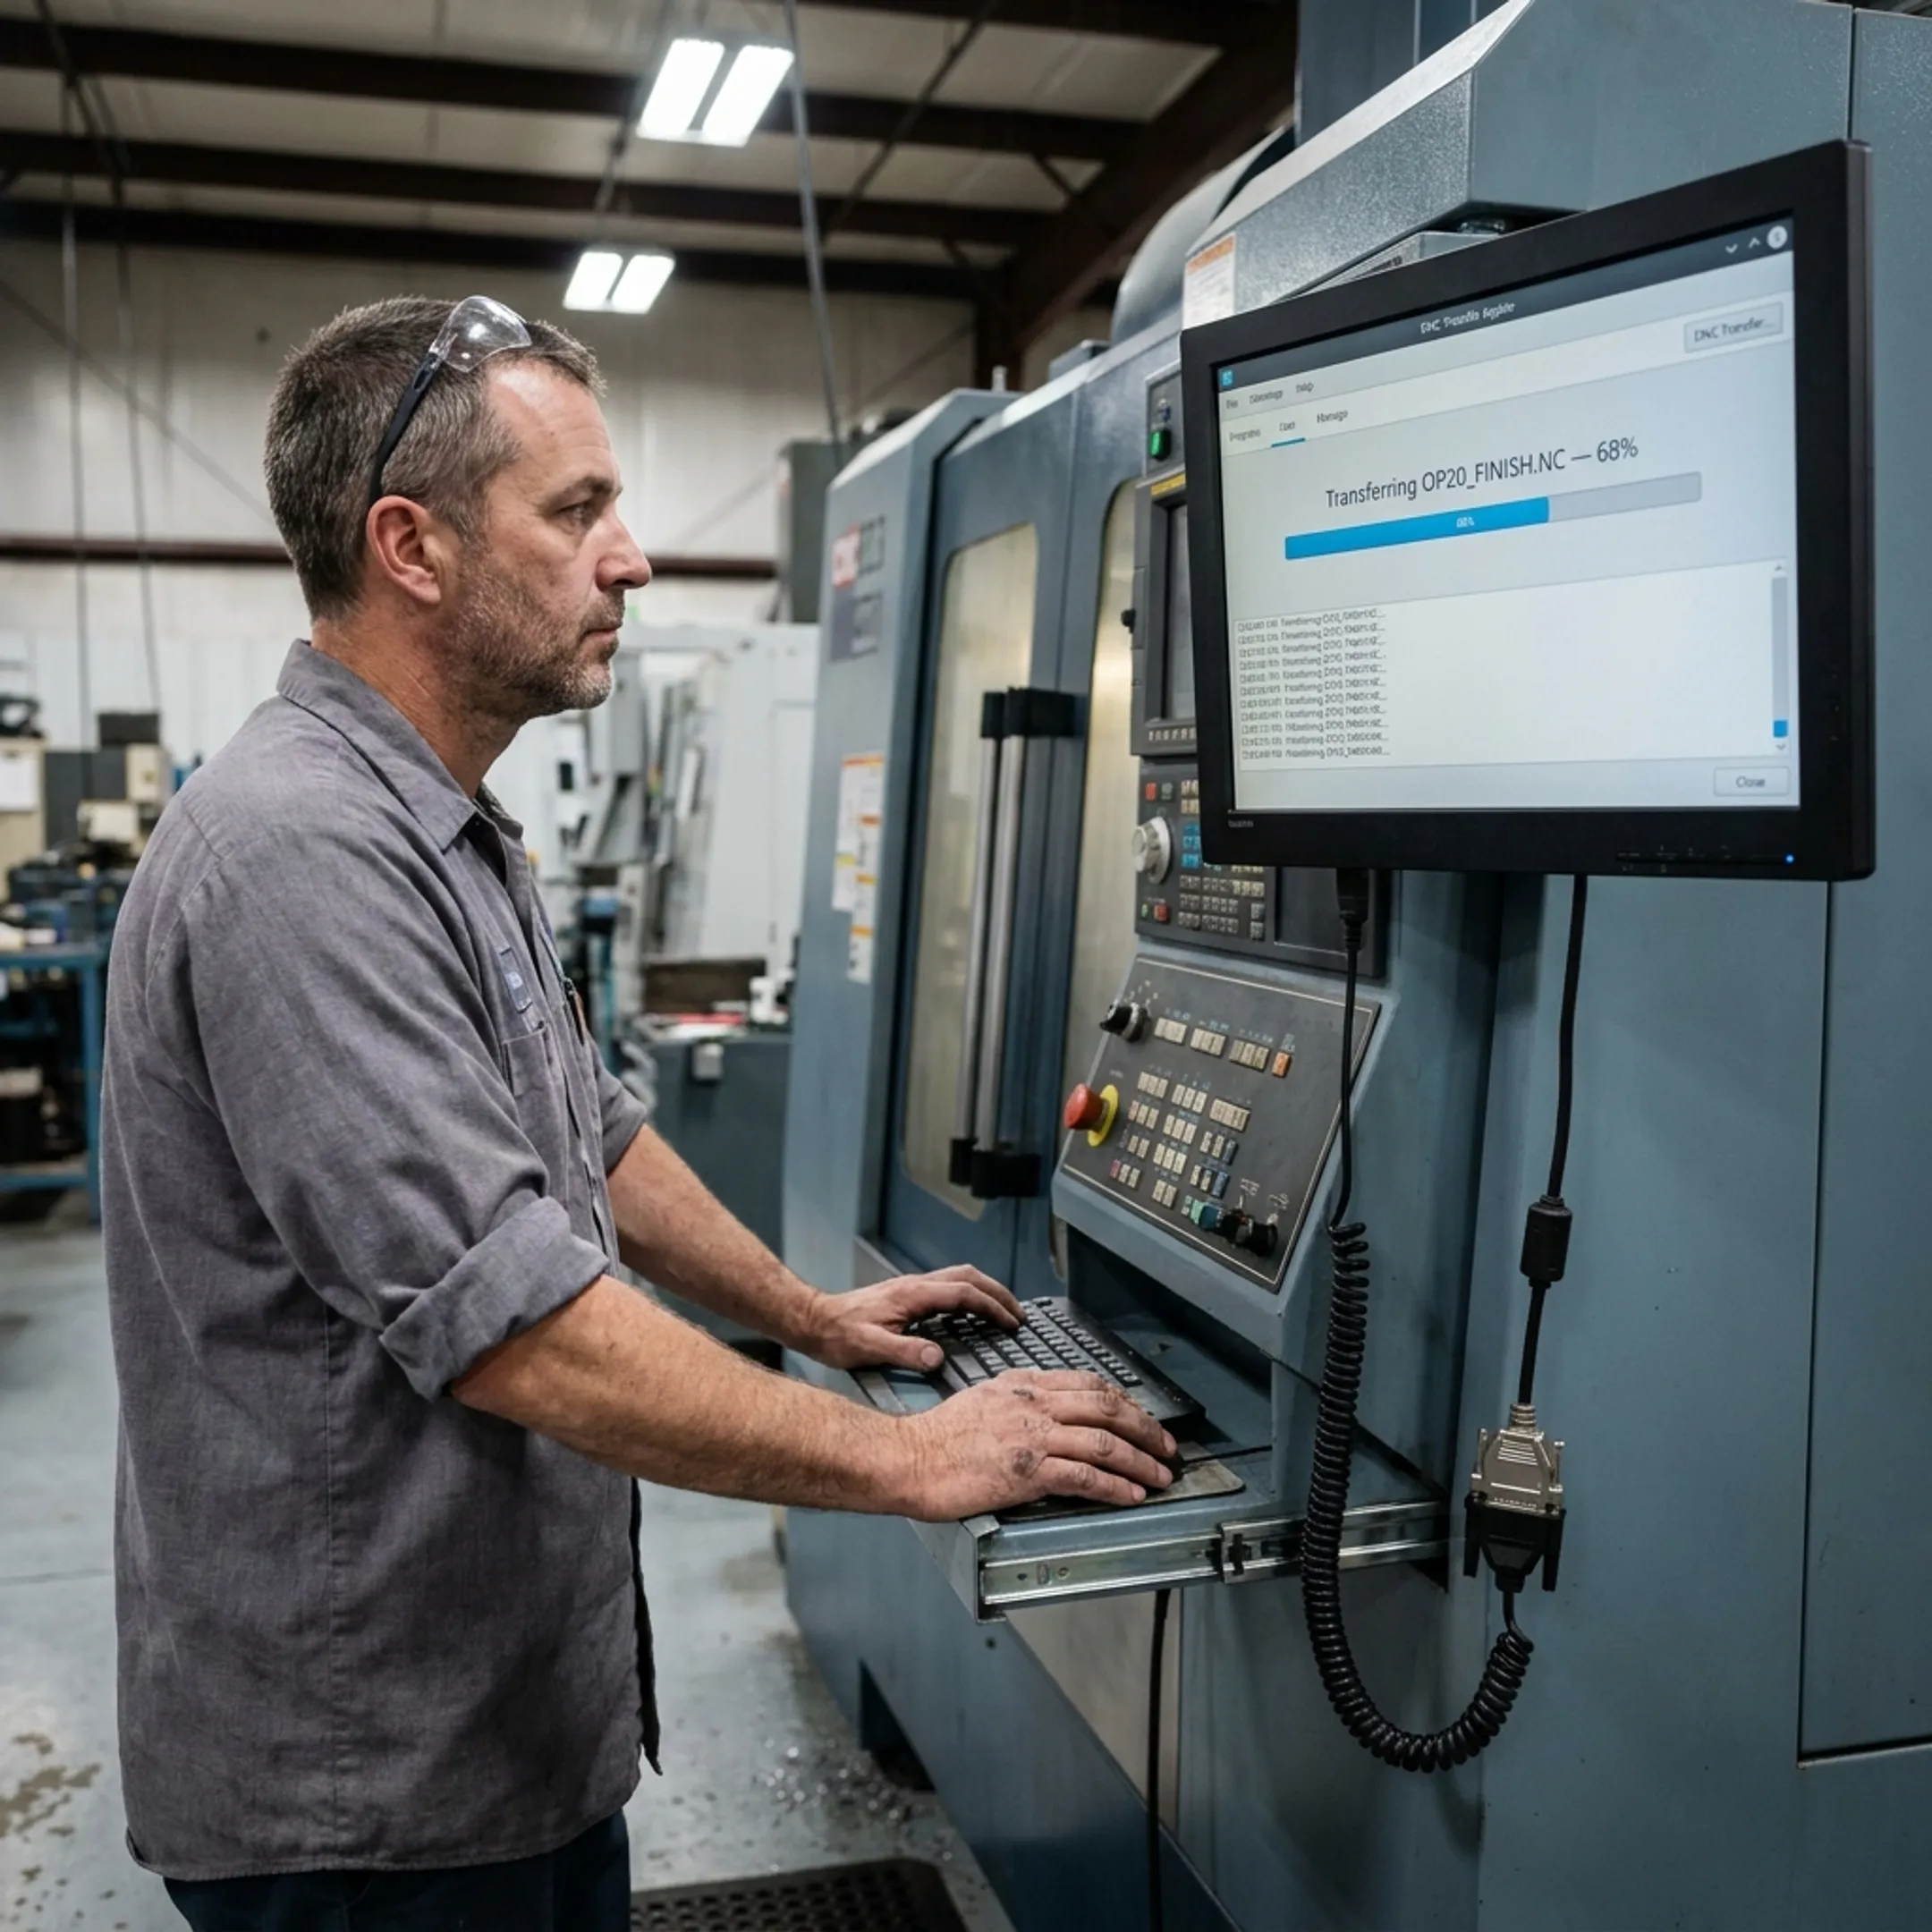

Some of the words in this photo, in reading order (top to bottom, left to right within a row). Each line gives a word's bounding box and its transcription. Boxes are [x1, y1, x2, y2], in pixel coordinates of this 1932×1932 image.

[1326, 478, 1417, 508] Transferring
[1421, 448, 1566, 493] OP20_FINISH.NC
[1597, 436, 1639, 463] 68%
